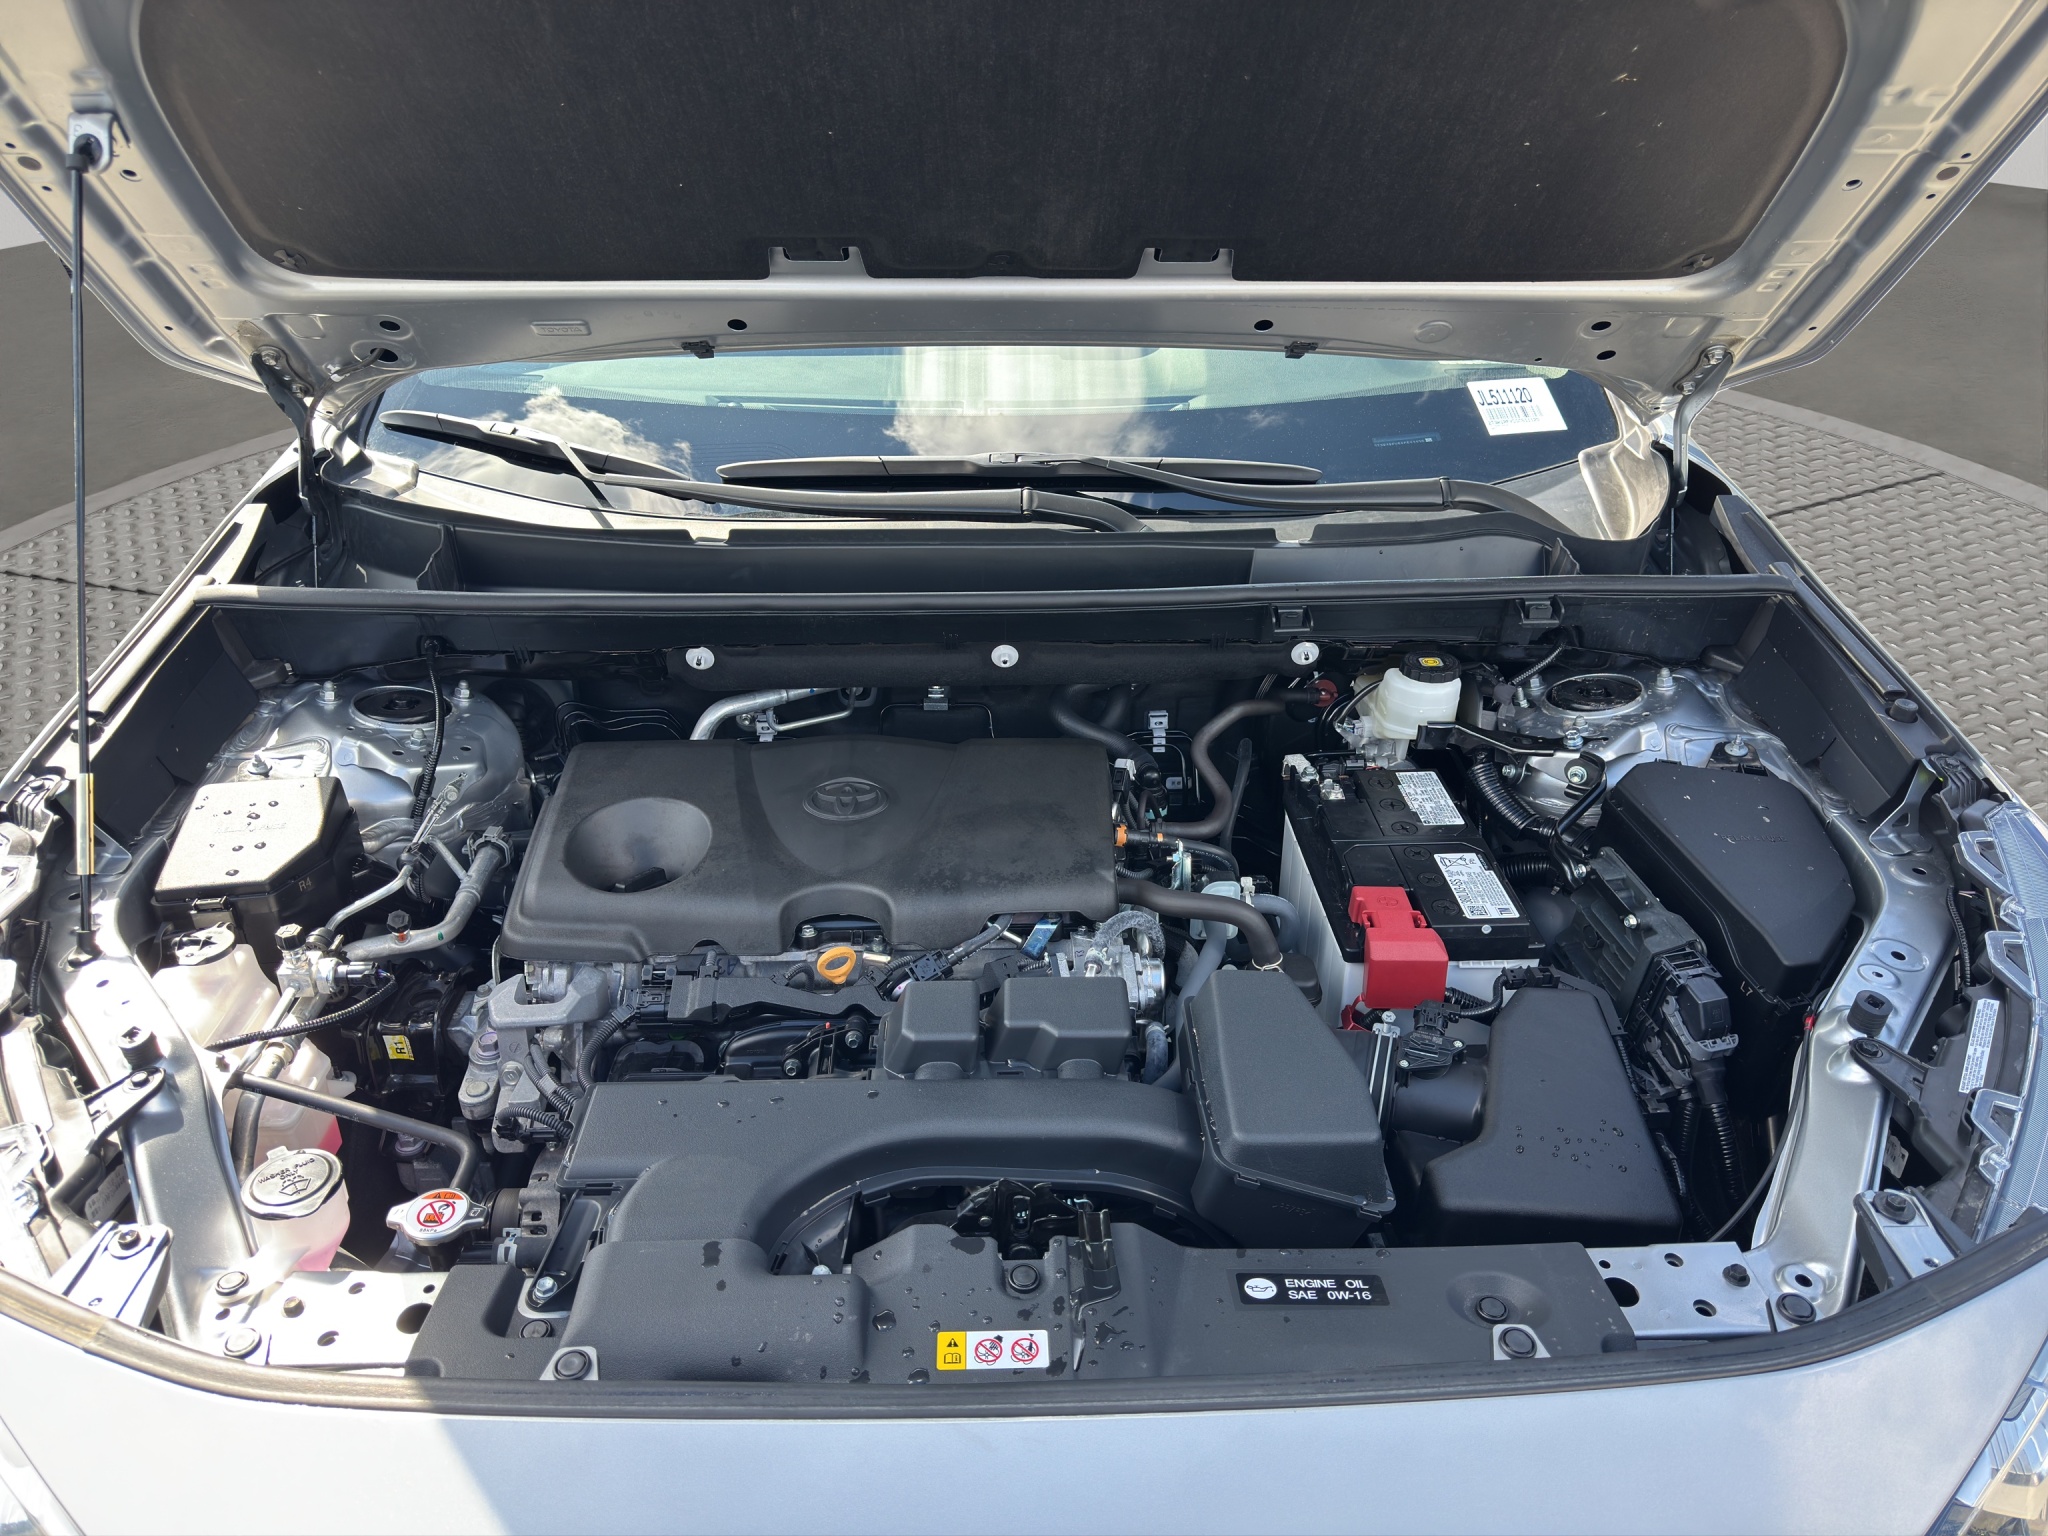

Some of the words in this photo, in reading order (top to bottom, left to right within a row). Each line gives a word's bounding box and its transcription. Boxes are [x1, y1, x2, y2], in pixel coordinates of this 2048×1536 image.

[1477, 387, 1533, 406] JL511120
[298, 876, 312, 892] R4
[394, 1041, 406, 1055] R1
[257, 1167, 291, 1184] WASHER
[280, 1169, 299, 1180] ONLY
[1284, 1278, 1337, 1289] ENGINE
[1345, 1279, 1369, 1289] OIL
[1288, 1290, 1318, 1300] SAE
[1327, 1290, 1372, 1300] 0W-16
